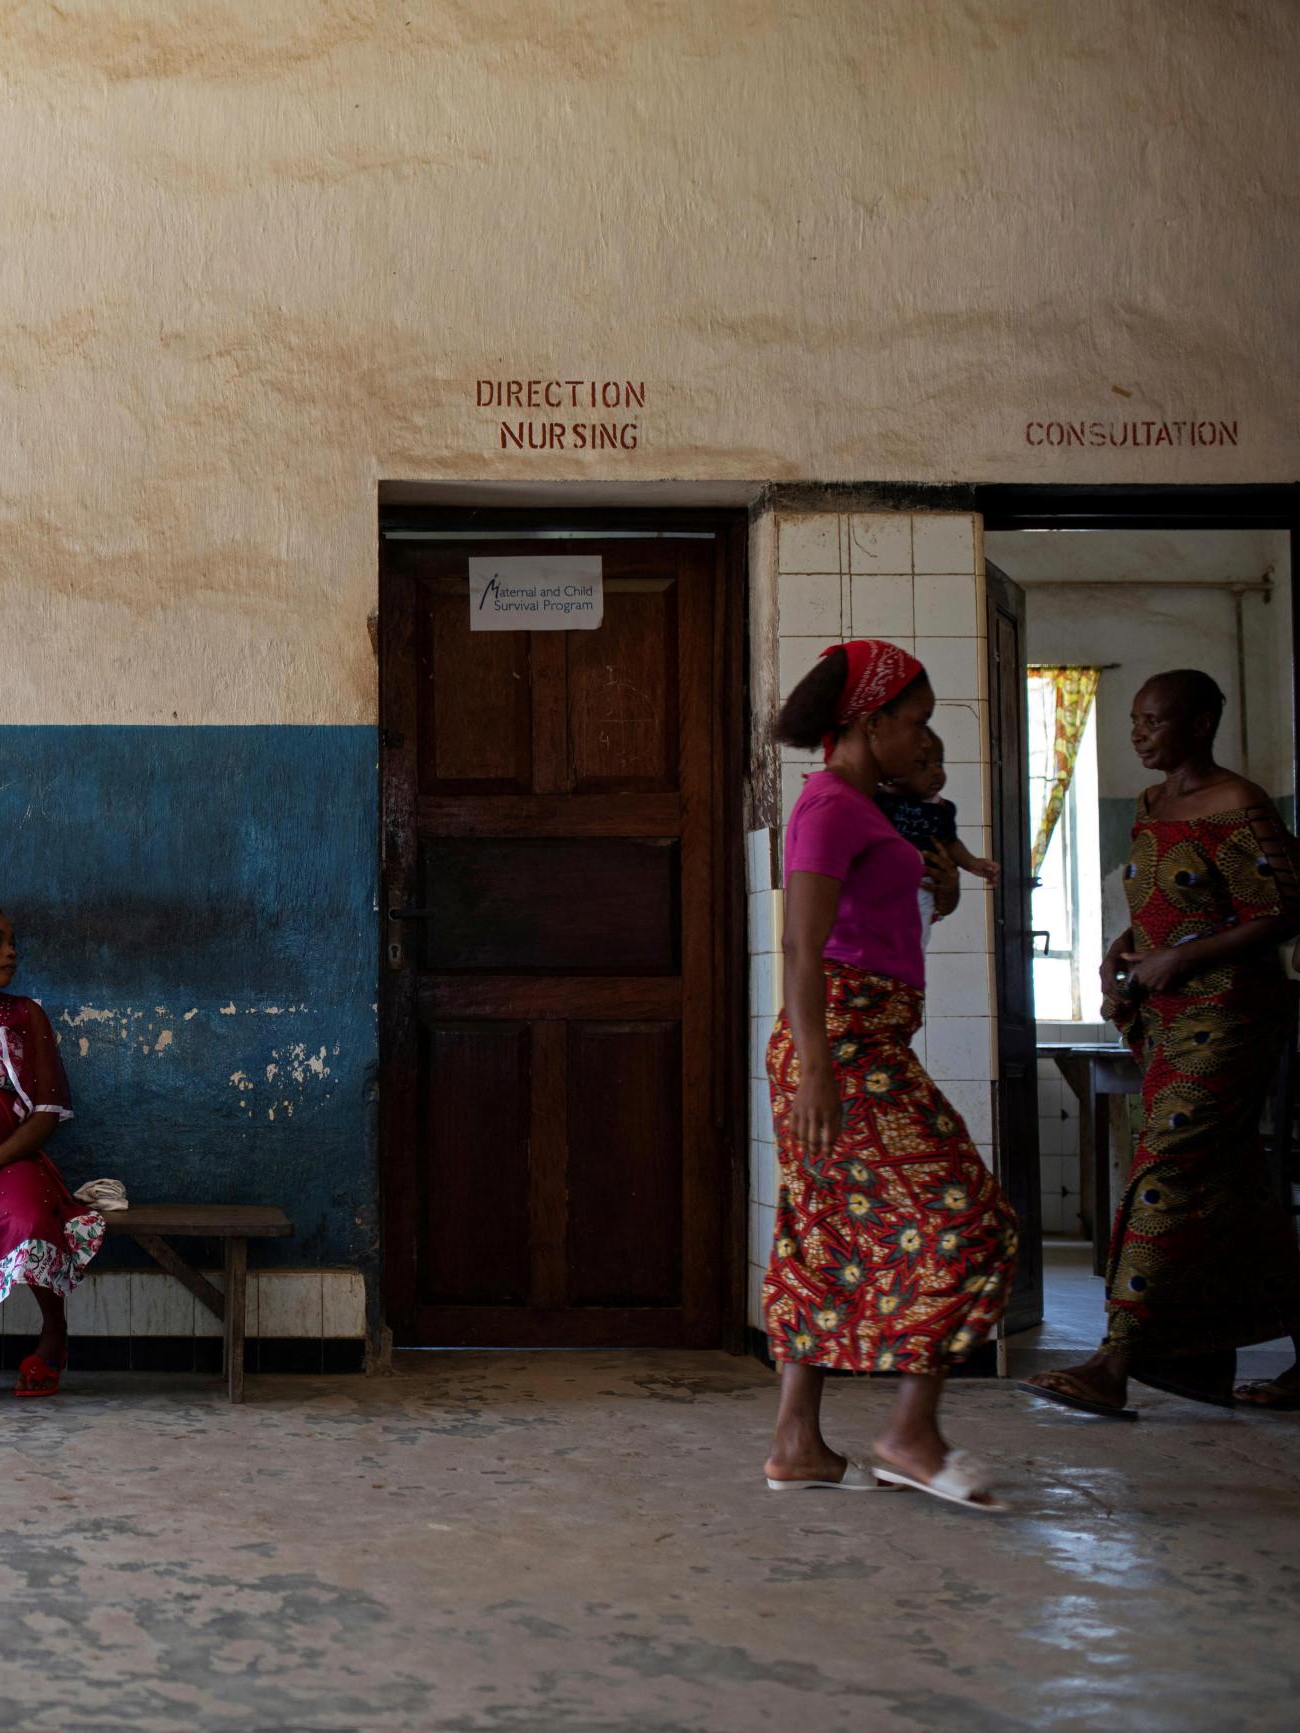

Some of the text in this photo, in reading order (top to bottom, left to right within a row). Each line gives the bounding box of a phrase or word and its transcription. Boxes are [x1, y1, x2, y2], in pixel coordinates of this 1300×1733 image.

[476, 380, 645, 408] DIRECTION
[500, 421, 638, 449] NURSING
[1025, 421, 1238, 446] CONSULTATION
[479, 573, 593, 610] Maternal and Child
[494, 600, 593, 613] Survival Program
